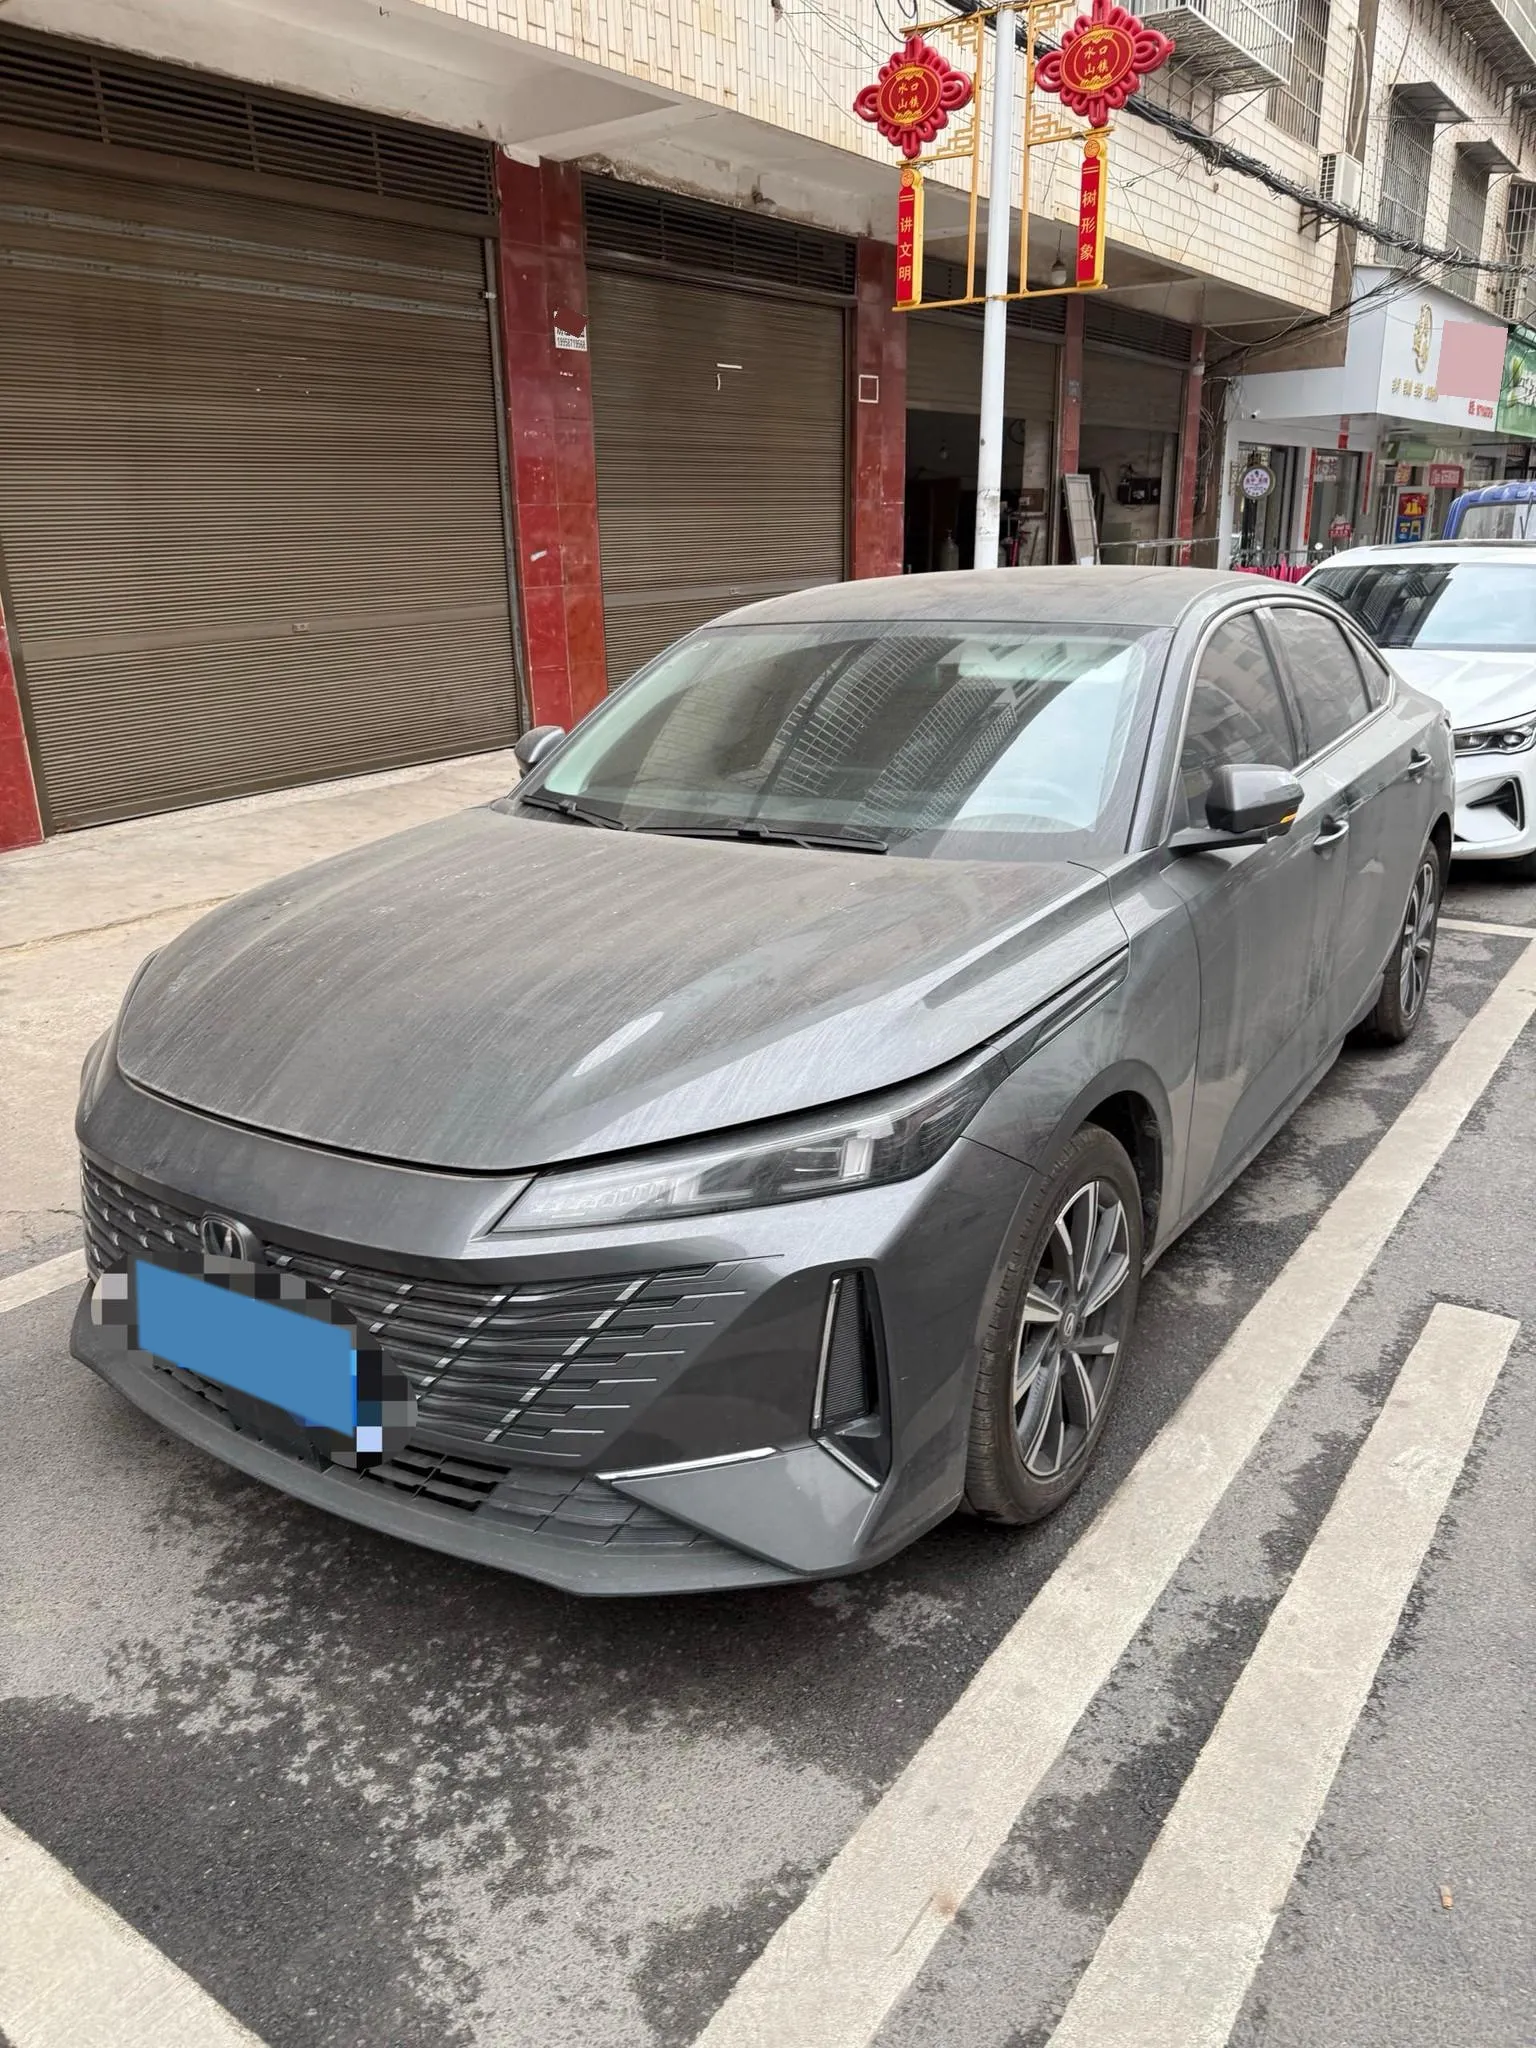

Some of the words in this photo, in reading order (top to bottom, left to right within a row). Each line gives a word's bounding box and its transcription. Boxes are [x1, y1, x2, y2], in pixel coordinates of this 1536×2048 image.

[898, 216, 914, 282] 讲文明
[1079, 190, 1097, 261] 树形象
